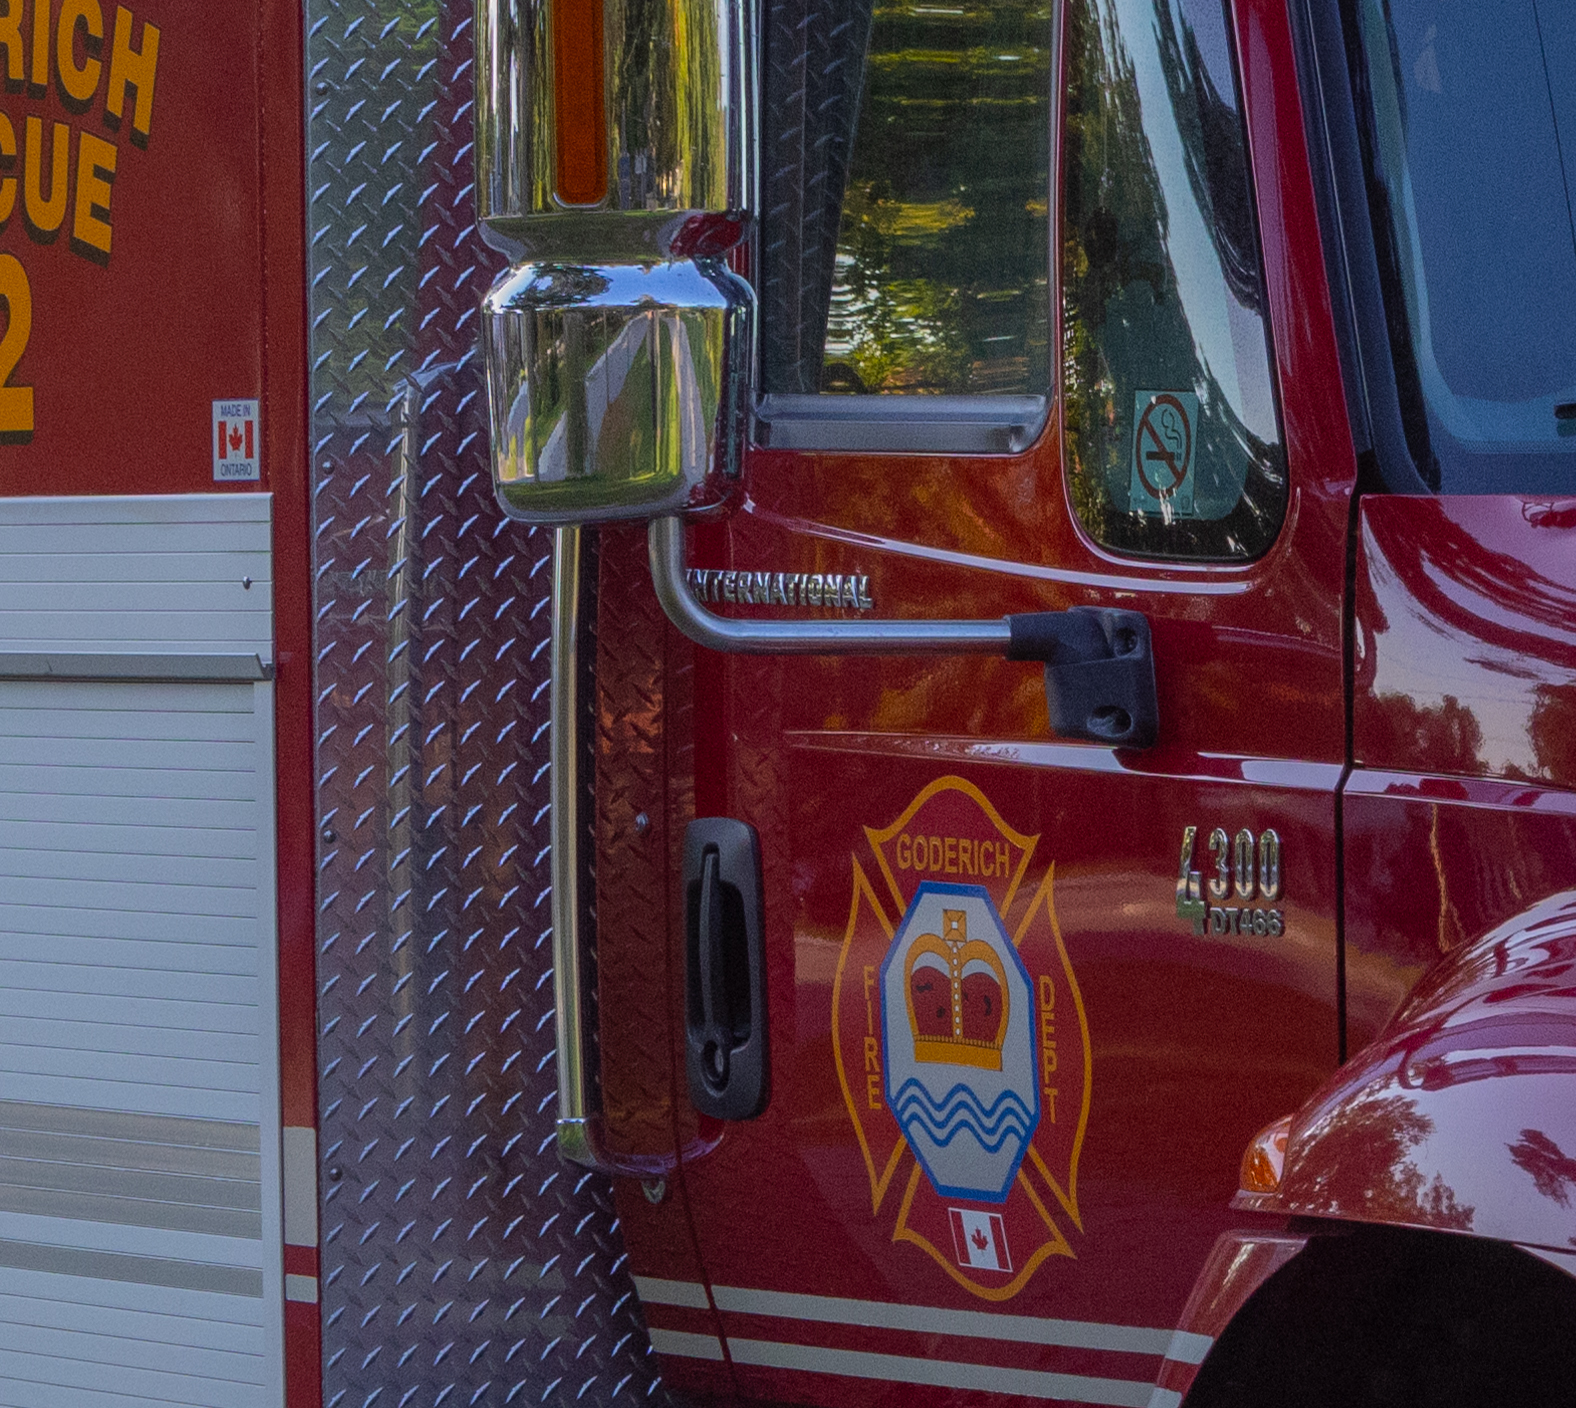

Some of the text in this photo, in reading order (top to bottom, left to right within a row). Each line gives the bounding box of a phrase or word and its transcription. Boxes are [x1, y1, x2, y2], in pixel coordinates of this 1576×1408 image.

[220, 404, 251, 417] MADE IN
[220, 463, 253, 477] ONTARIO
[895, 833, 1011, 878] GODERICH
[1176, 825, 1281, 936] 4300
[1209, 907, 1283, 936] DT466
[862, 965, 882, 1110] FIRE
[1038, 974, 1058, 1125] DEPT
